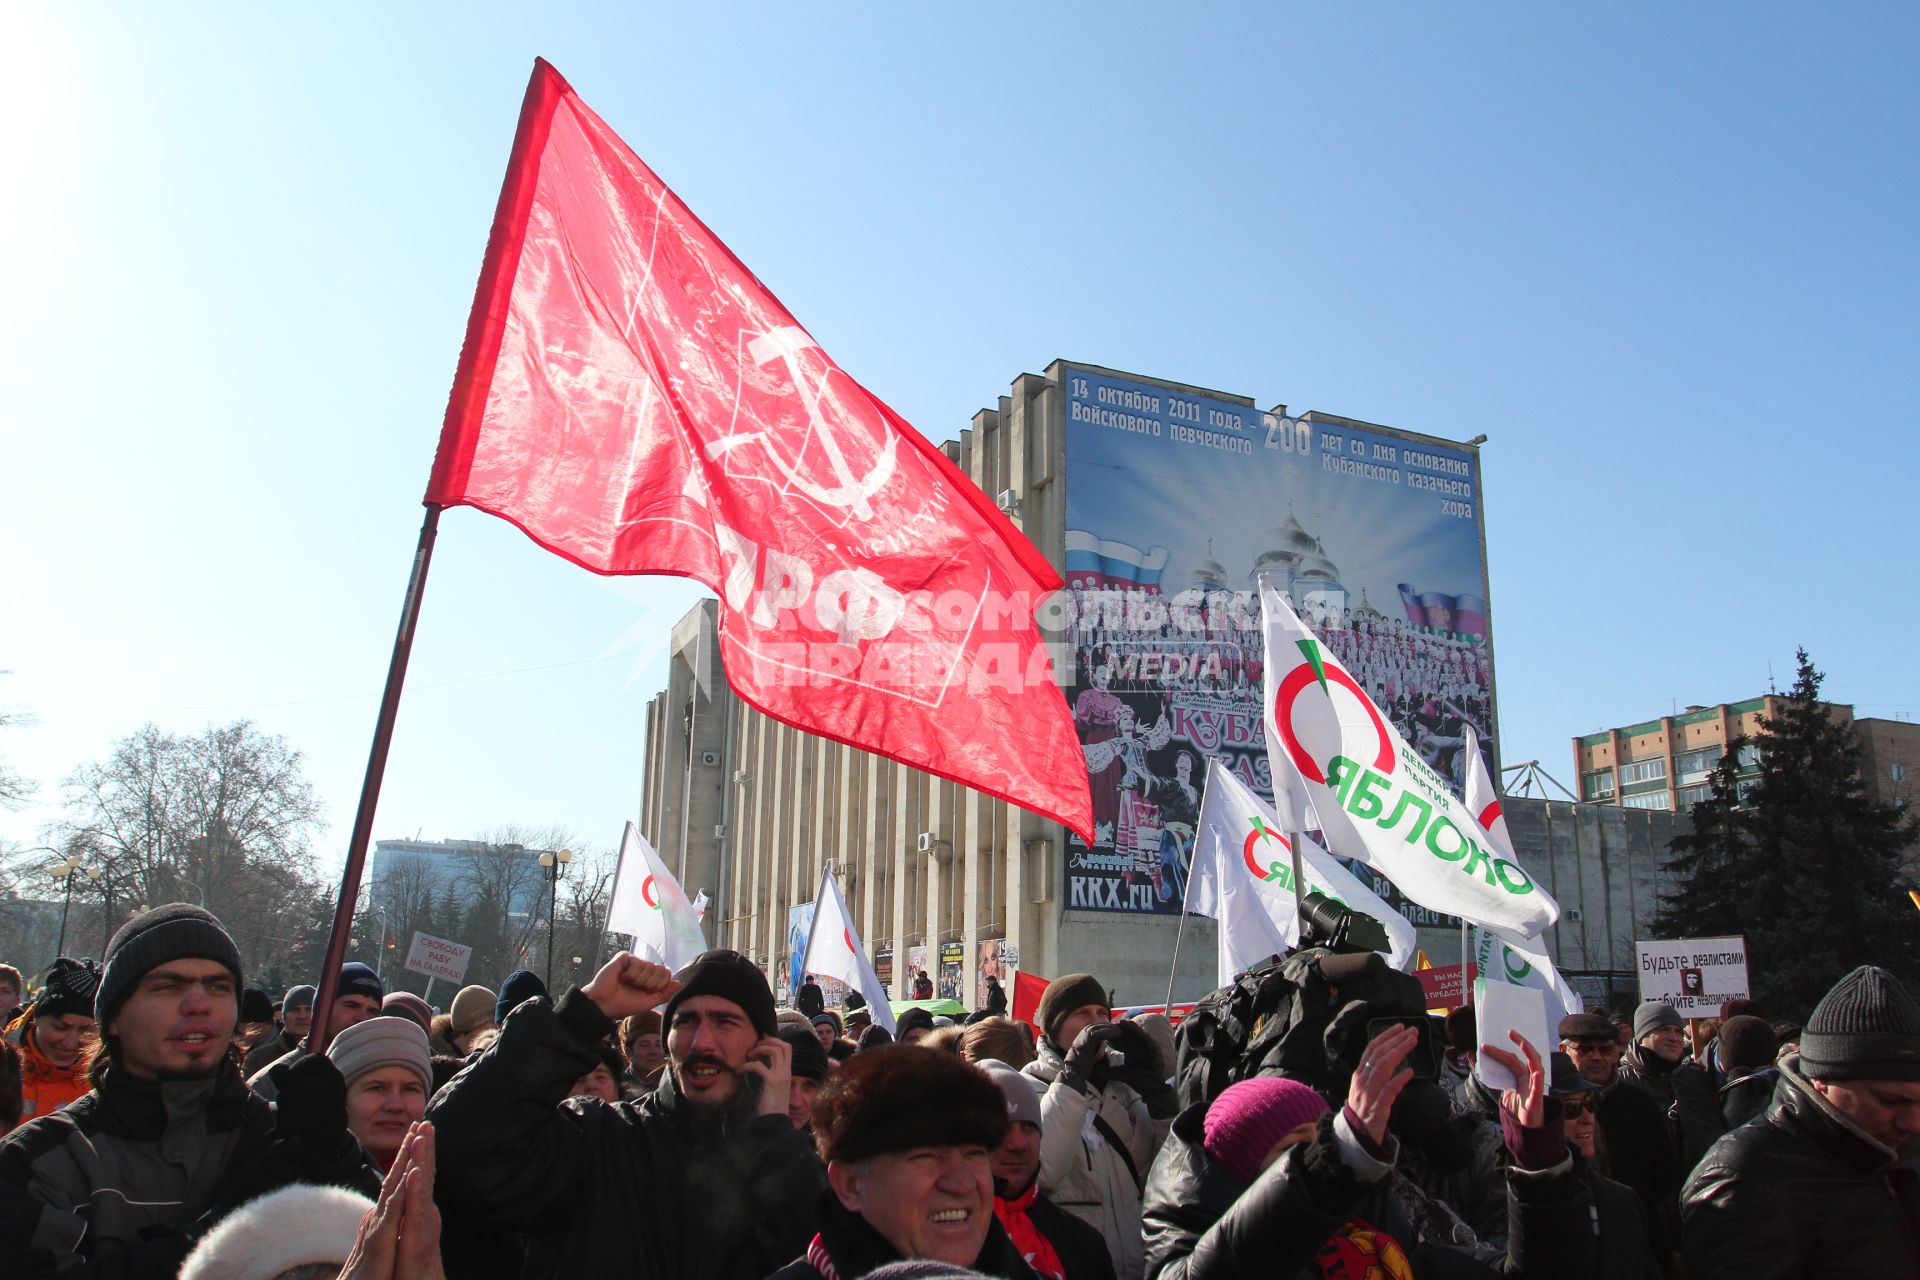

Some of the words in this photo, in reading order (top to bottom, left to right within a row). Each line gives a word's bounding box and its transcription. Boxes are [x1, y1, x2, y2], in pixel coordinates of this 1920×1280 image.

[1071, 378, 1089, 399] 14
[1098, 386, 1161, 414] октября
[1168, 398, 1200, 422] 2011
[1209, 410, 1242, 431] года
[1263, 413, 1311, 456] 200
[1321, 432, 1343, 450] лет
[1350, 438, 1365, 456] со
[1372, 443, 1396, 463] дня
[1404, 450, 1470, 477] основания
[1071, 400, 1161, 437] Войскового
[1169, 422, 1252, 455] певческого
[1321, 452, 1400, 485] Кубанского
[1407, 471, 1471, 498] казачьего
[1173, 707, 1266, 749] КУБА
[1404, 763, 1450, 811] ПАРТИЯ
[1325, 755, 1535, 895] ЯБЛОКО
[1400, 903, 1440, 925] благо
[420, 938, 465, 957] СВОБОДУ
[429, 951, 451, 963] РАБУ
[410, 958, 421, 968] НА
[1642, 953, 1688, 975] Будьте
[1692, 951, 1745, 969] реалистами
[1646, 992, 1695, 1009] буйте
